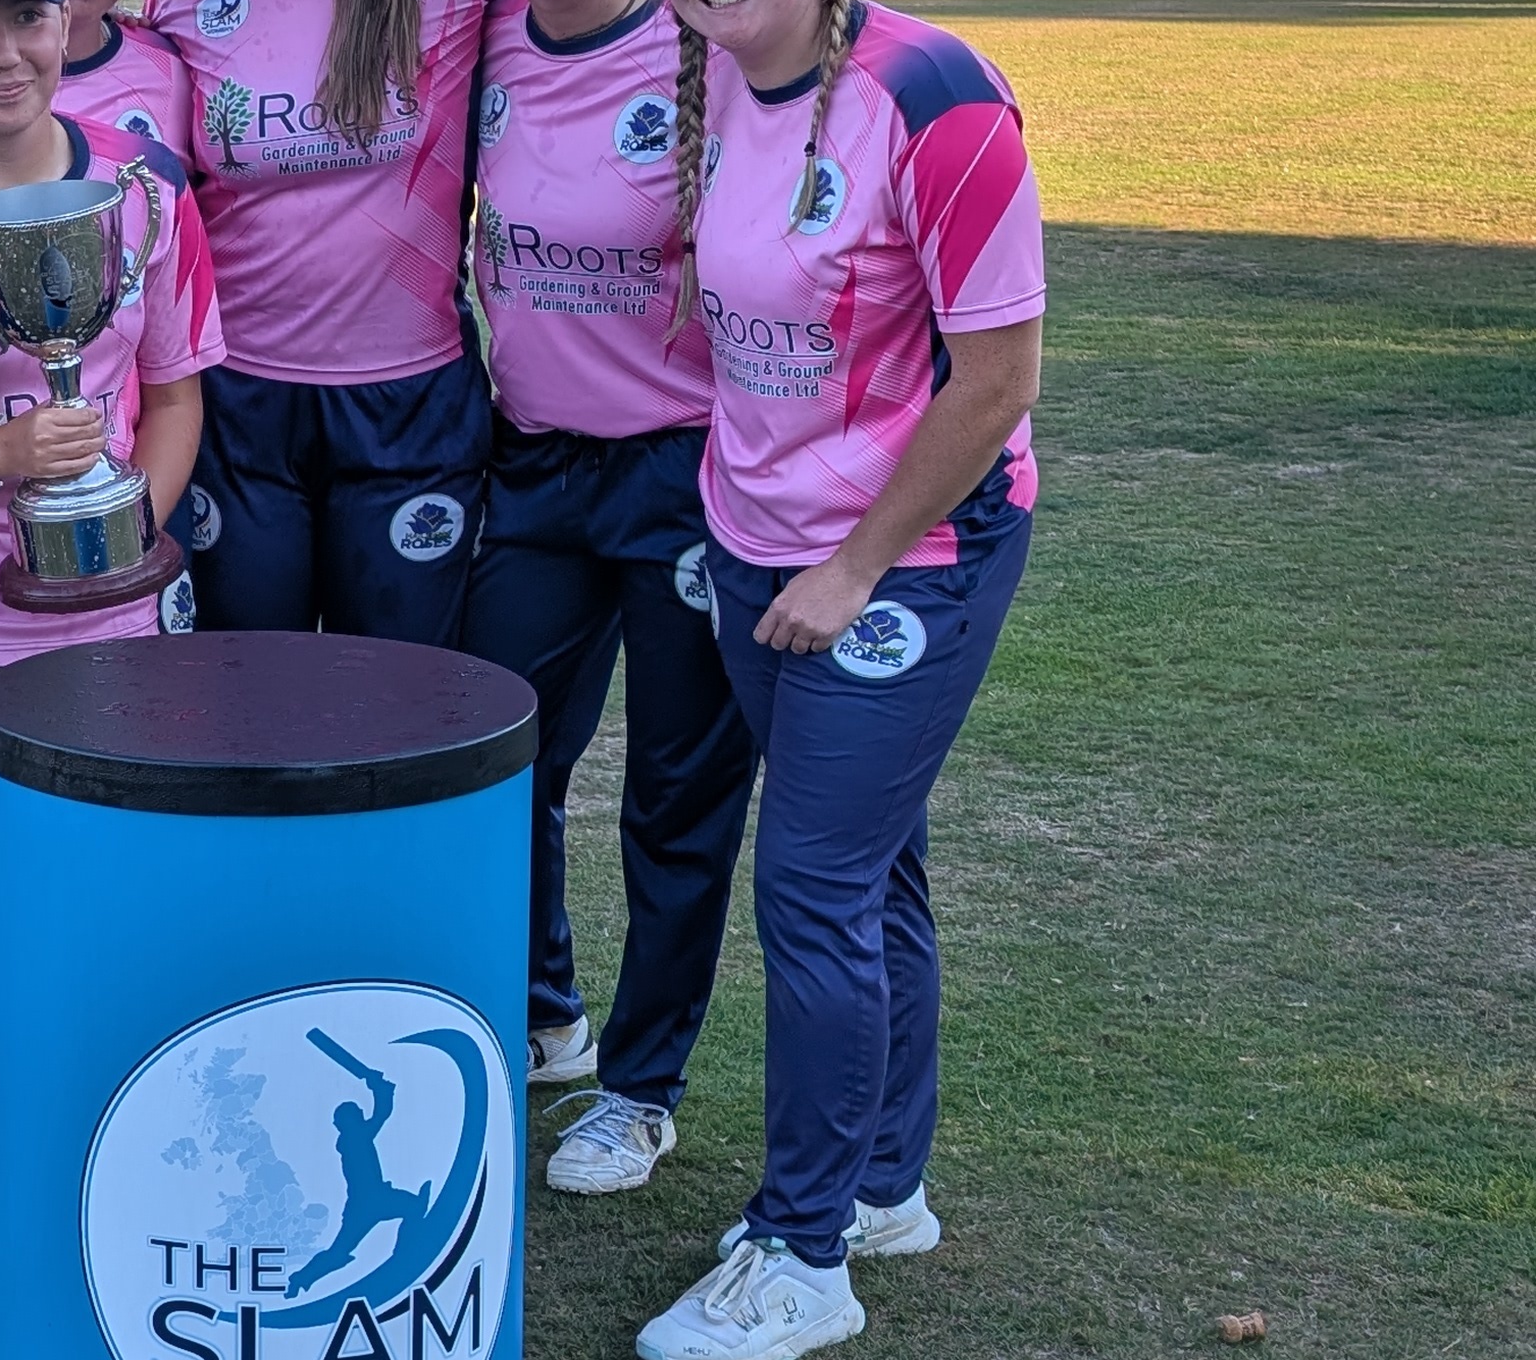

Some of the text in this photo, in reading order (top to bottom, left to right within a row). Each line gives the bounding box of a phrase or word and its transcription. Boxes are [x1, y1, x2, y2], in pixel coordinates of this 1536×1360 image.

[261, 125, 416, 161] Gardening & Ground
[620, 139, 668, 151] ROSES
[278, 145, 401, 175] Maintenance Ltd
[508, 223, 664, 274] ROOTS
[519, 275, 661, 298] Gardening & Ground
[531, 296, 647, 315] Maintenance Ltd
[702, 288, 835, 353] ROOTS
[763, 360, 773, 376] &
[778, 359, 833, 379] Ground
[796, 381, 820, 398] Ltd
[400, 538, 452, 549] ROSES
[837, 641, 904, 669] ROSES
[150, 1238, 287, 1292] THE
